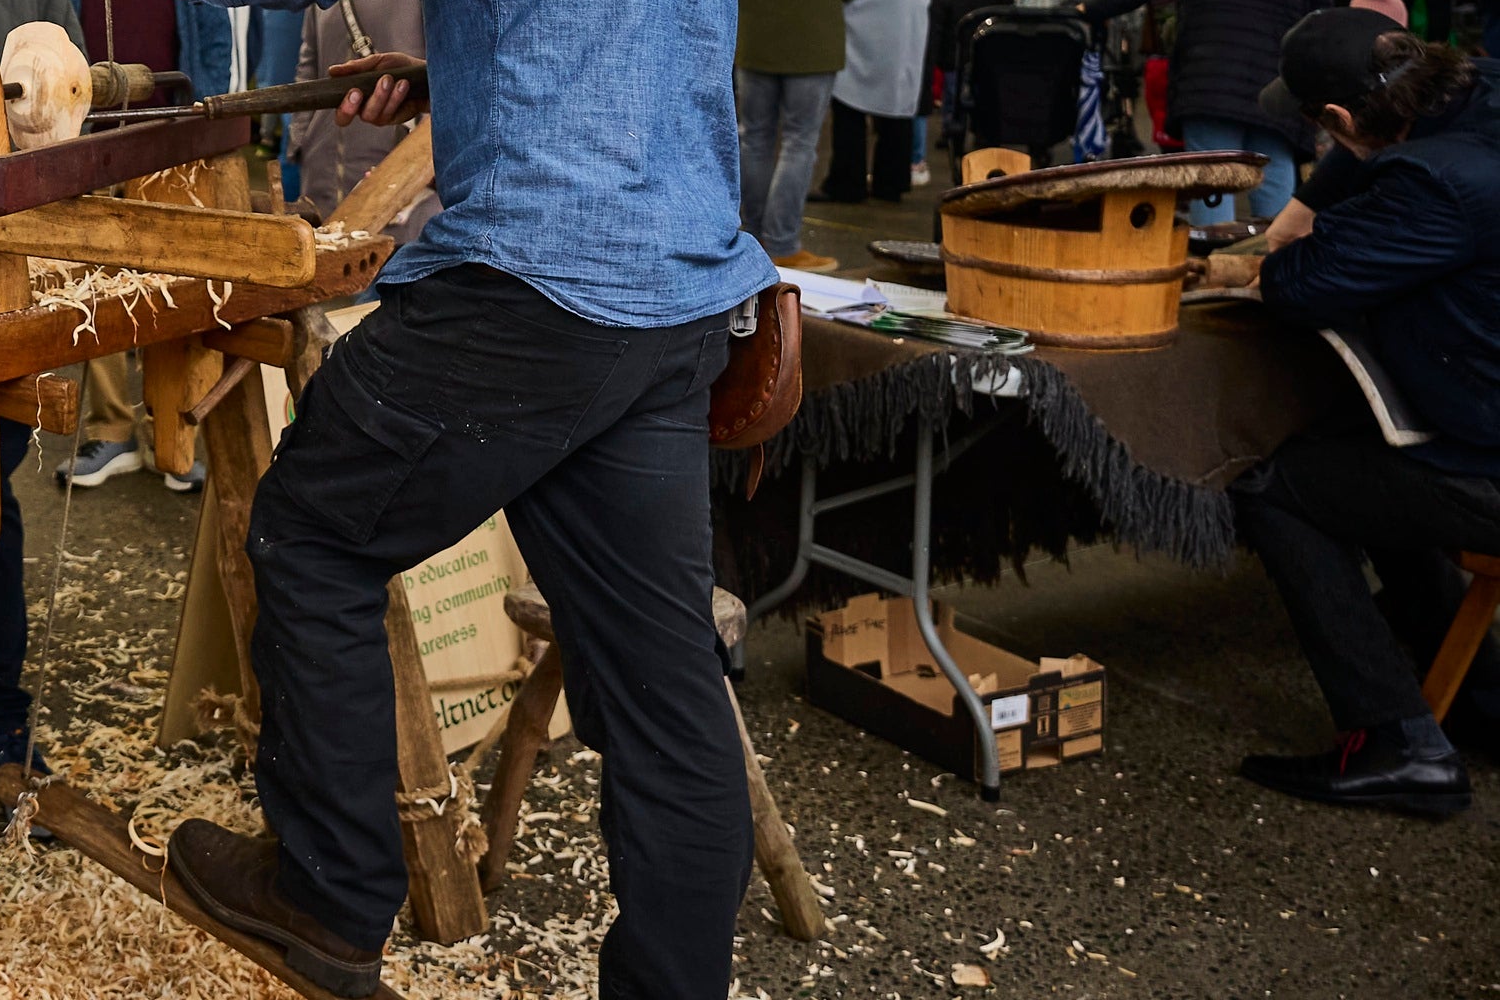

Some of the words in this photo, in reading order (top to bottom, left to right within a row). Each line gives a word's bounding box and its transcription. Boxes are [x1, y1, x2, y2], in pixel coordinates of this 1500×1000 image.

[419, 549, 489, 586] education
[436, 574, 512, 614] community
[419, 622, 478, 656] areness
